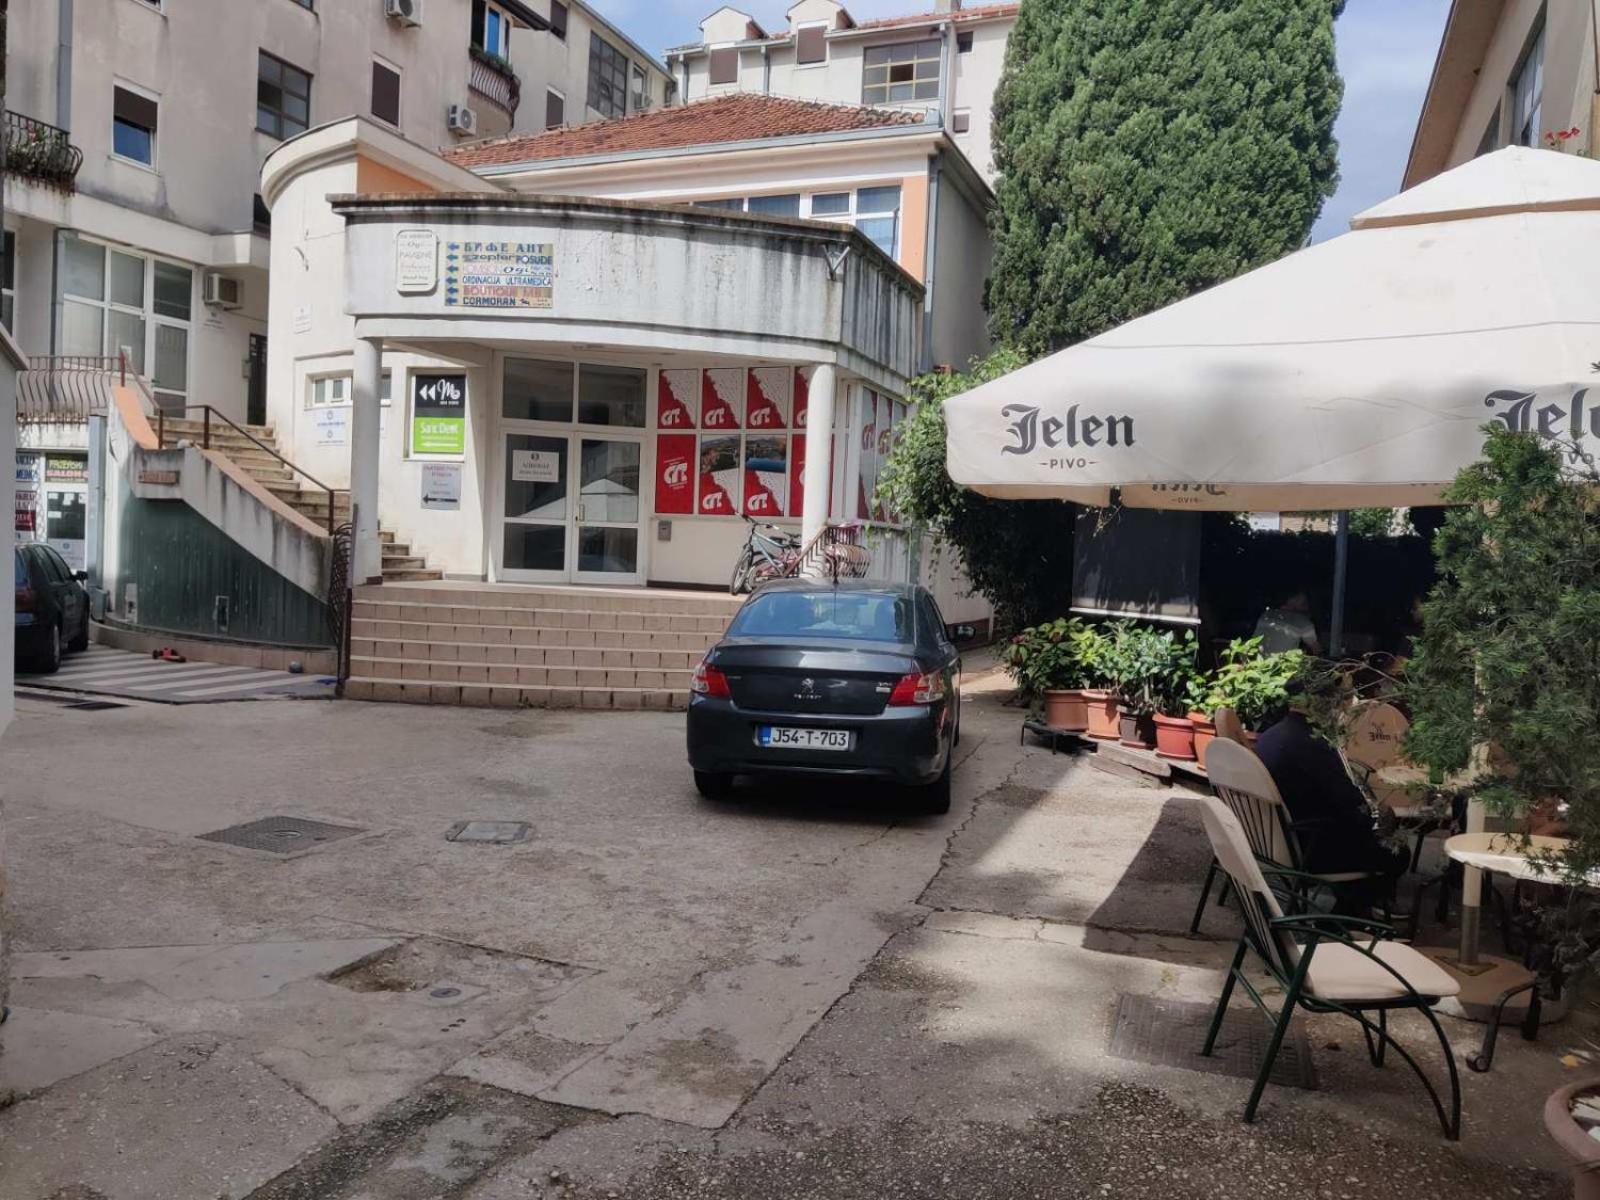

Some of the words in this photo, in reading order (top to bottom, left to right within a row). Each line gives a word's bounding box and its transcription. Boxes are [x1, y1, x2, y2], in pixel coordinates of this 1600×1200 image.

[515, 255, 553, 265] POSUDE
[462, 275, 501, 285] ORDINACIJA
[463, 296, 516, 306] CORMORAN
[1001, 403, 1136, 456] Jelen
[1050, 458, 1087, 469] PIVO
[772, 729, 847, 747] J54-T-703
